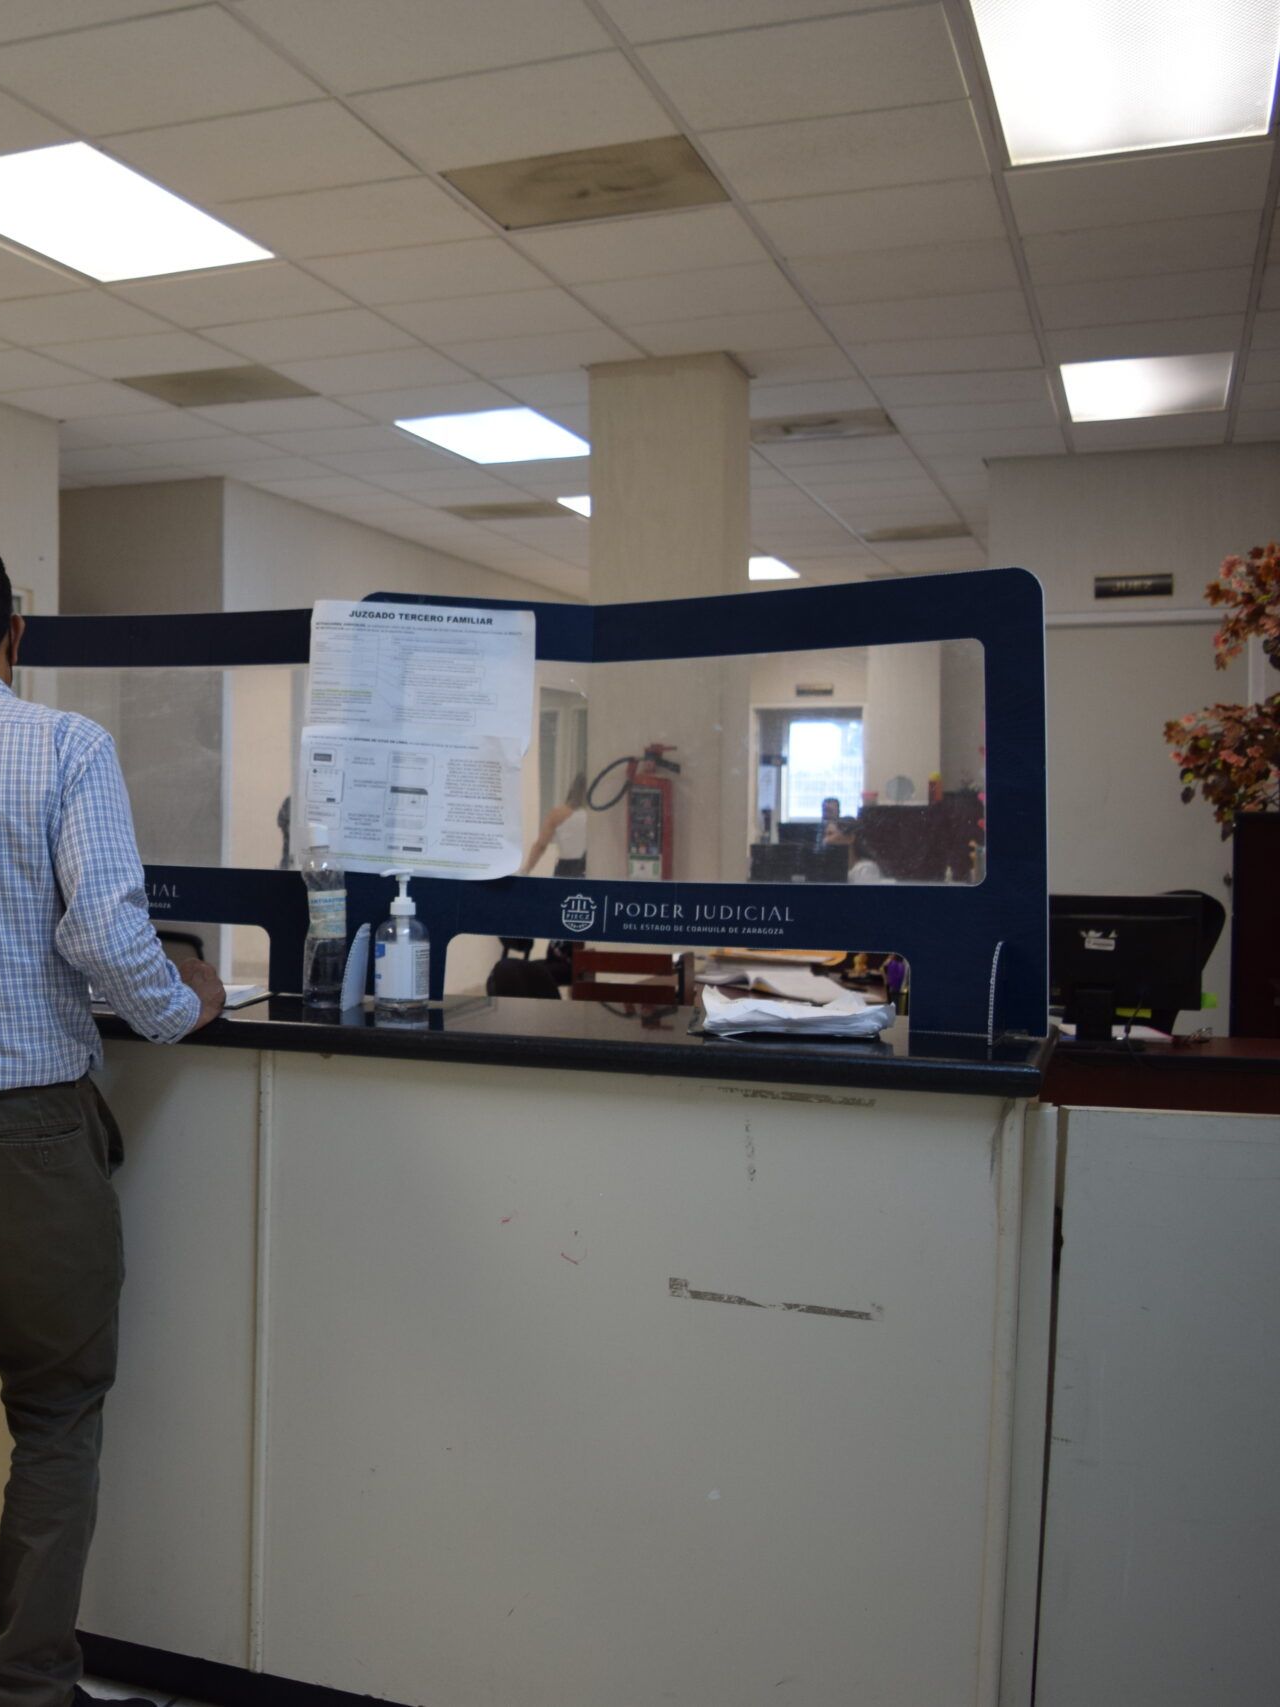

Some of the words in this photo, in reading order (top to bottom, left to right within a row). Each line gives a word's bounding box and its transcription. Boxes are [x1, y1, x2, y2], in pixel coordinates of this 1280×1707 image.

[349, 610, 396, 620] JUZGADO
[399, 613, 444, 623] TERCERO
[447, 616, 493, 626] FAMILIAR
[614, 902, 684, 919] PODER
[695, 904, 795, 922] JUDICIAL
[623, 923, 638, 931] DEL
[640, 923, 671, 932] ESTADO
[674, 924, 685, 932] DE
[686, 925, 726, 934] COAHUILA
[728, 926, 739, 934] DE
[741, 927, 785, 935] ZARAGOZA
